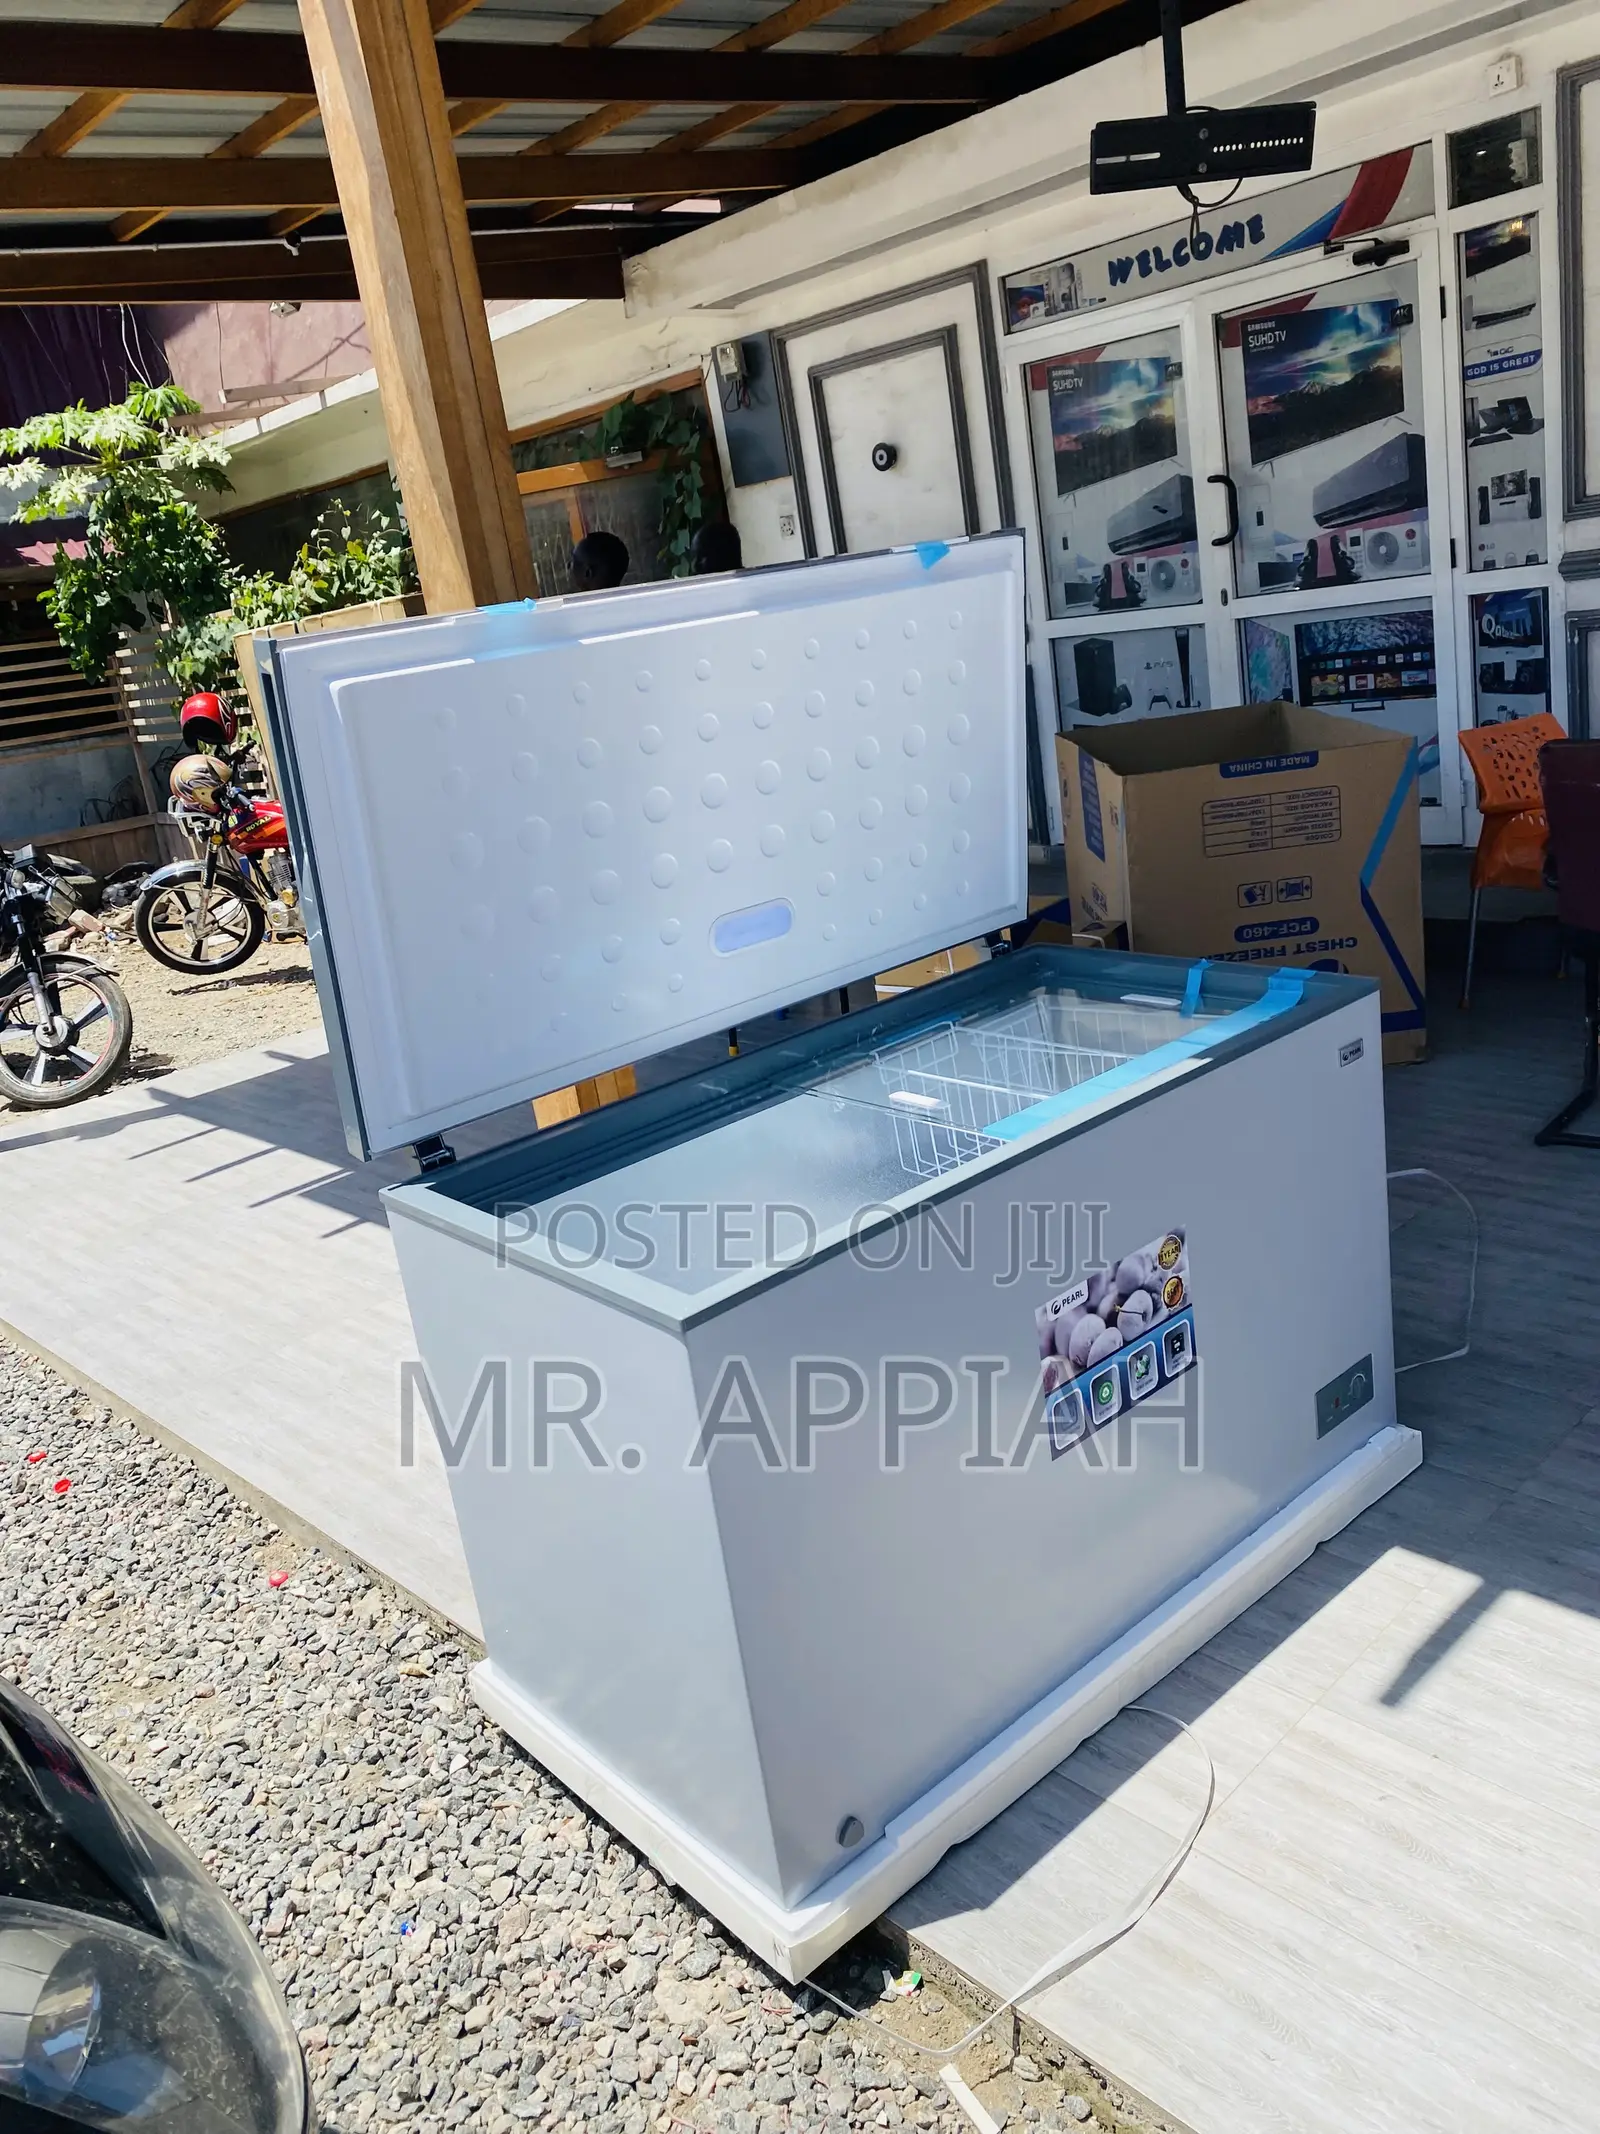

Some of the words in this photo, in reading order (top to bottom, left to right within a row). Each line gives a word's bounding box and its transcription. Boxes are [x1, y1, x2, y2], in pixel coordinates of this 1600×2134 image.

[1108, 213, 1265, 286] WELCOME
[1247, 320, 1276, 332] SAMSUNG
[1467, 365, 1487, 376] GOD
[1490, 362, 1500, 371] IS
[1502, 354, 1536, 369] GREAT
[1153, 660, 1174, 668] PS5
[1265, 760, 1277, 768] IN
[1280, 755, 1310, 766] MADE
[1229, 762, 1263, 773] CHINA
[1301, 789, 1333, 798] PRODUCT
[1301, 800, 1333, 810] PACKAGE
[245, 815, 271, 832] ROYAL
[1243, 920, 1312, 939] PCF-460
[1293, 936, 1358, 955] CHEST
[1061, 1289, 1085, 1307] PEARL
